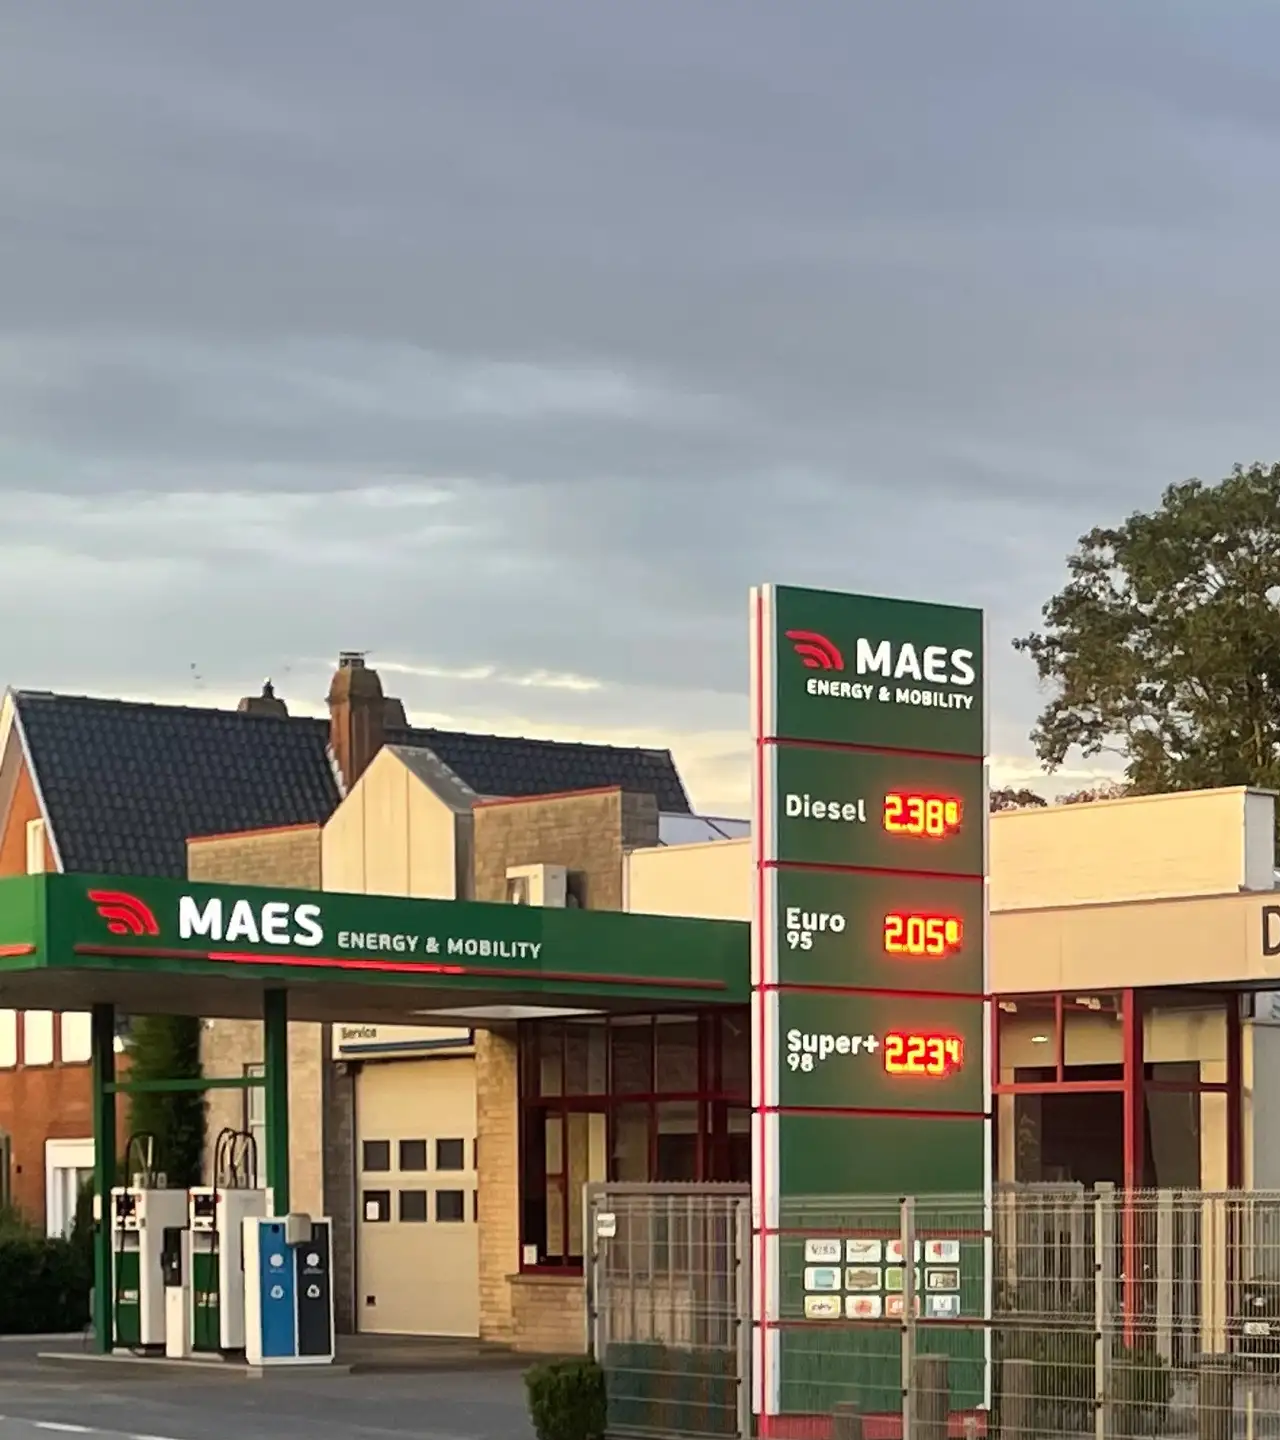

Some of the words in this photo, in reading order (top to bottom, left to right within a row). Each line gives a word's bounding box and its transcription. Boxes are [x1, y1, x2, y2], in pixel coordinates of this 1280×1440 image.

[856, 638, 975, 686] MAES
[806, 678, 873, 701] ENERGY
[878, 687, 890, 701] &
[896, 687, 973, 709] MOBILITY
[786, 794, 867, 823] Diesel
[179, 896, 323, 947] MAES
[786, 907, 846, 932] Euro
[337, 932, 419, 953] ENERGY
[426, 937, 440, 954] &
[447, 937, 542, 960] MOBILITY
[786, 932, 813, 950] 95
[787, 1030, 879, 1060] Super+
[787, 1053, 814, 1072] 98
